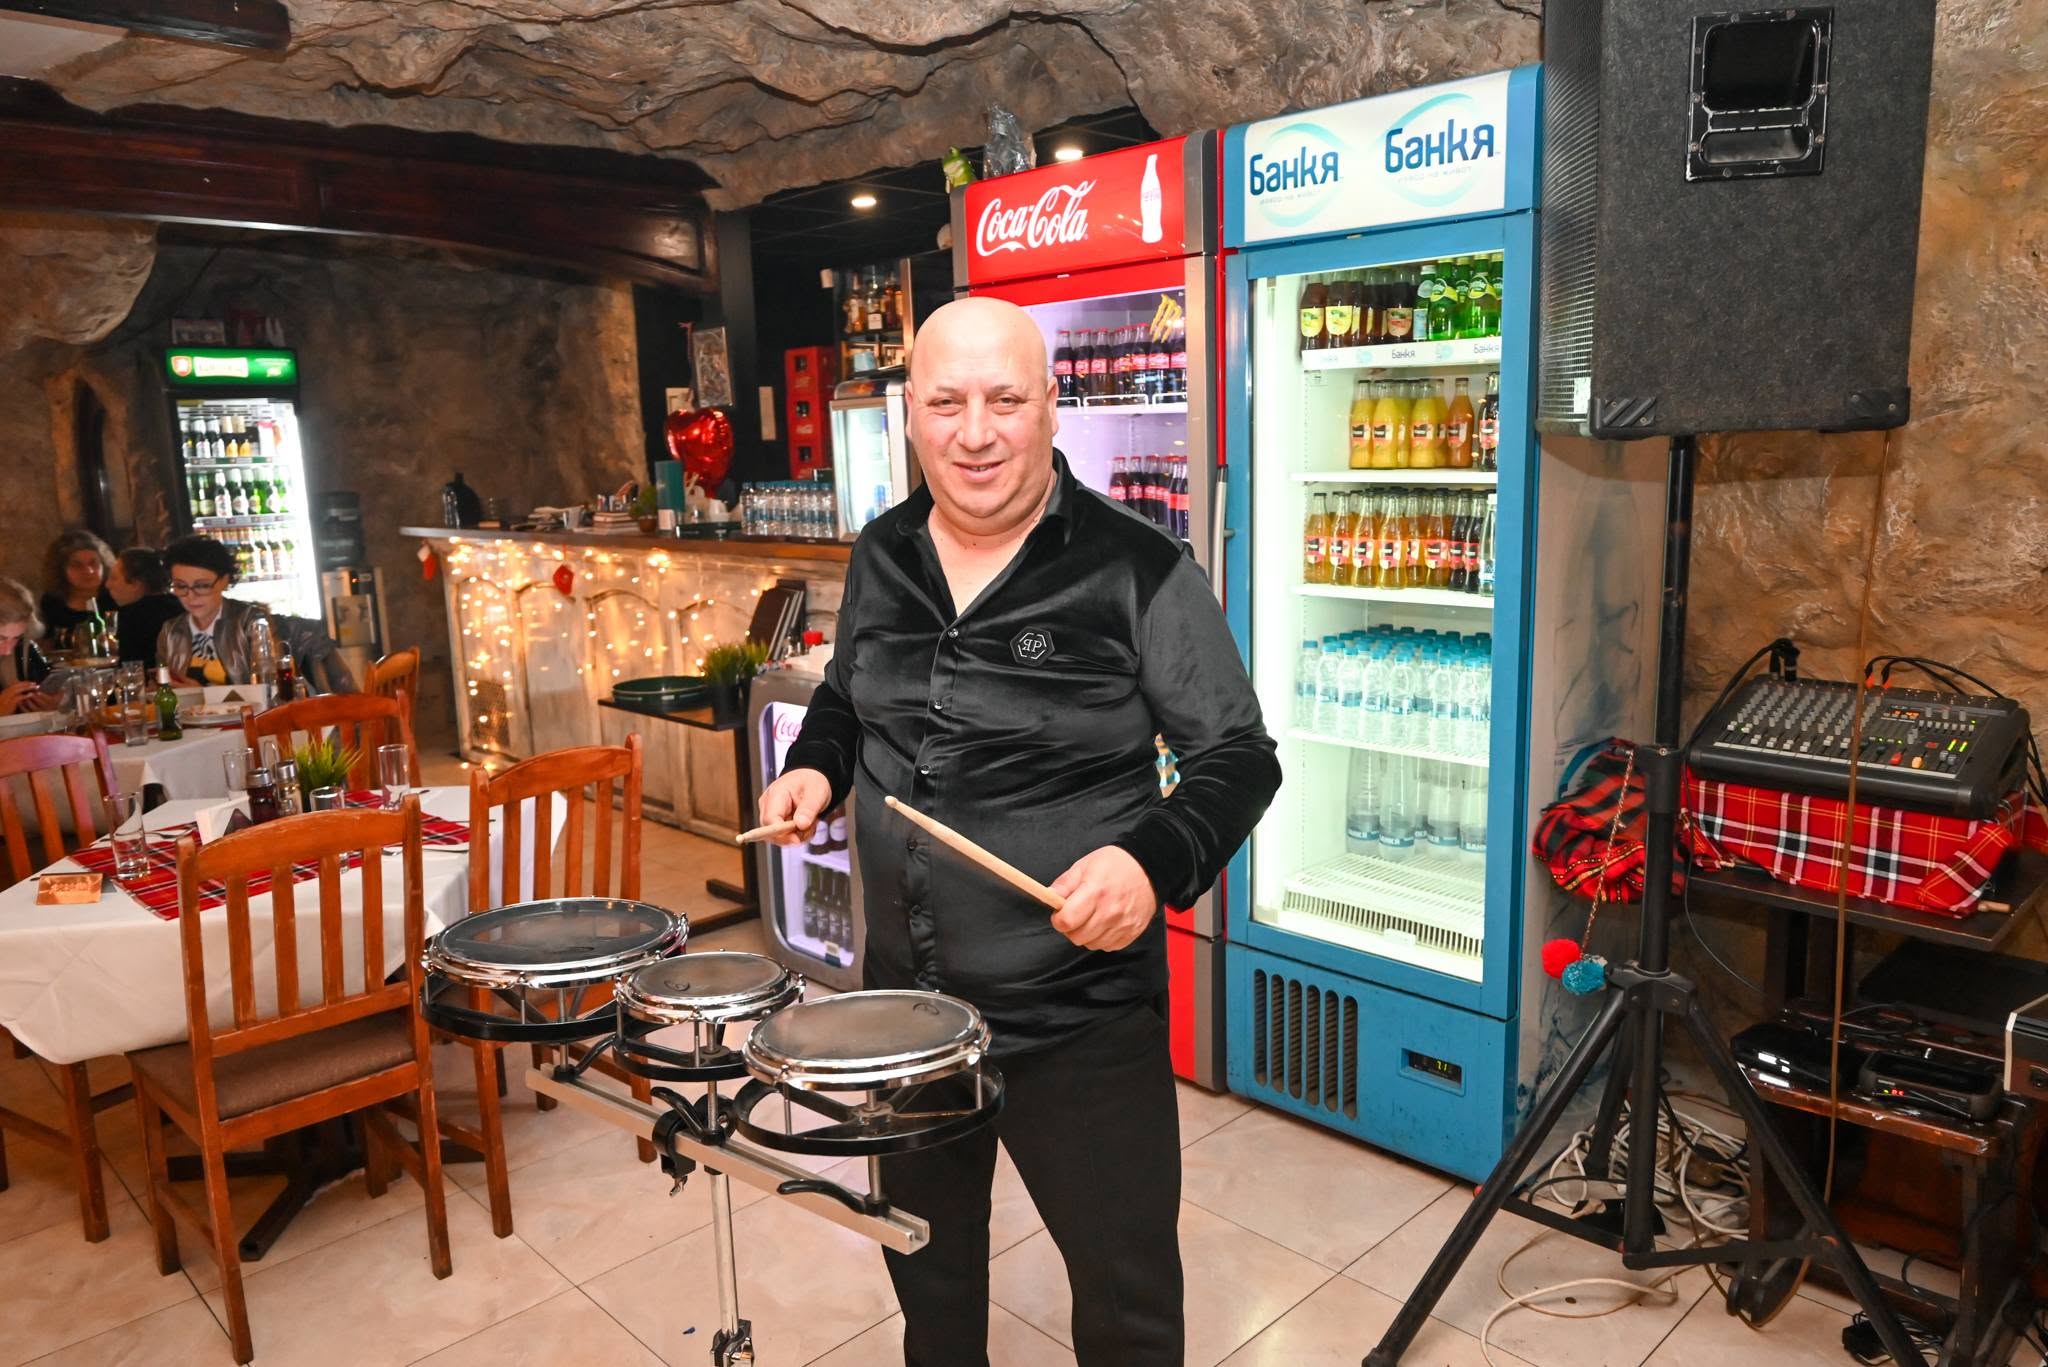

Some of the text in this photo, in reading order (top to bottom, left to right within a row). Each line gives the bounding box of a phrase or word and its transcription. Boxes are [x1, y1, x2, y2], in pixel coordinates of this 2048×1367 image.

[1249, 146, 1339, 196] Банкя
[1385, 118, 1494, 173] Банкя
[976, 179, 1097, 257] Coca-Cola
